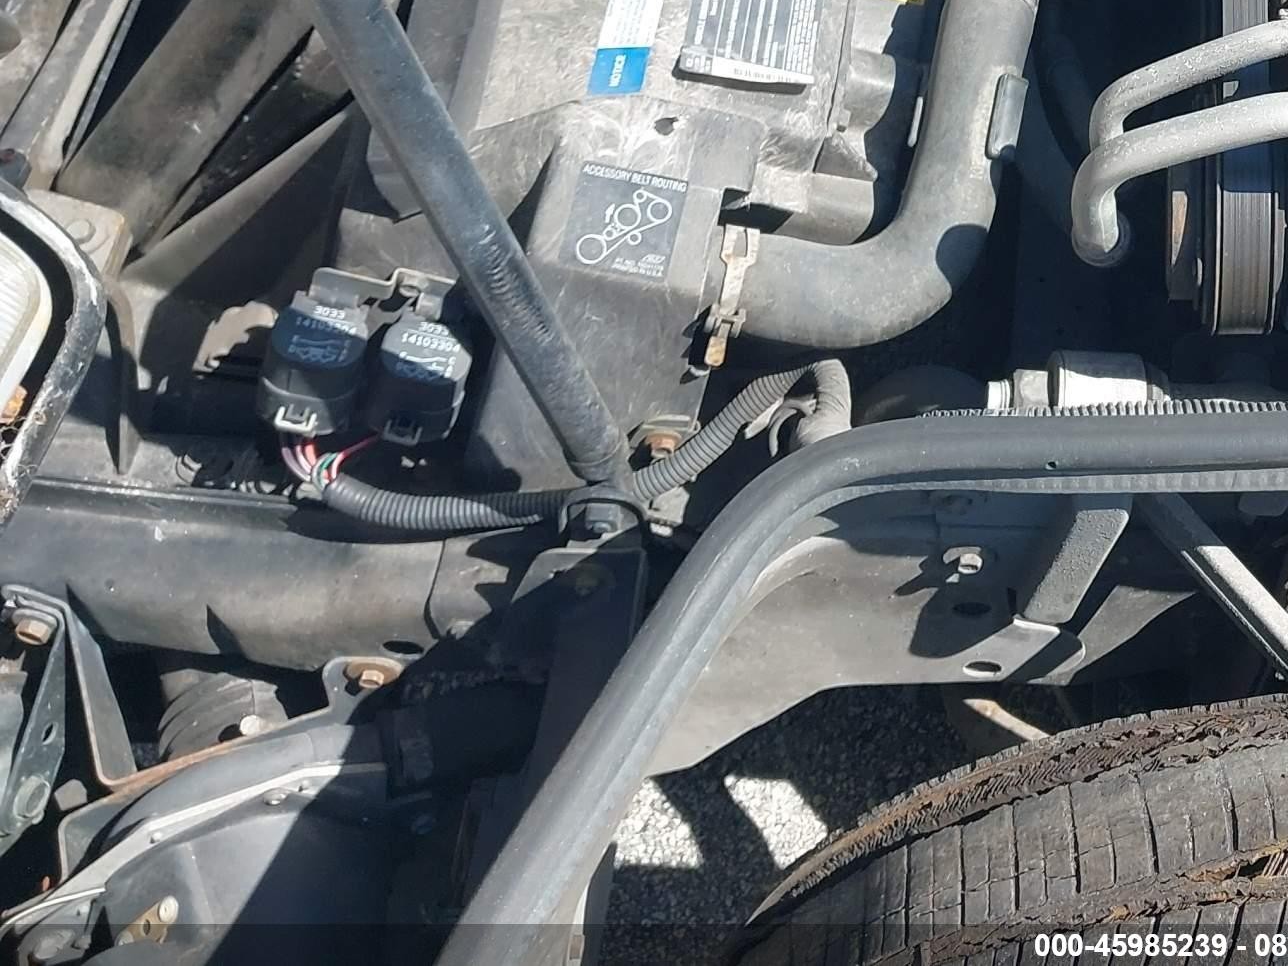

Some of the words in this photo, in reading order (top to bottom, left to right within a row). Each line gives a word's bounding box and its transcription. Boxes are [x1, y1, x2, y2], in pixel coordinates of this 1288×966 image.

[582, 163, 632, 181] ACCESSORY
[631, 172, 652, 185] BELT
[651, 176, 688, 193] ROUTING
[314, 305, 346, 319] 3033
